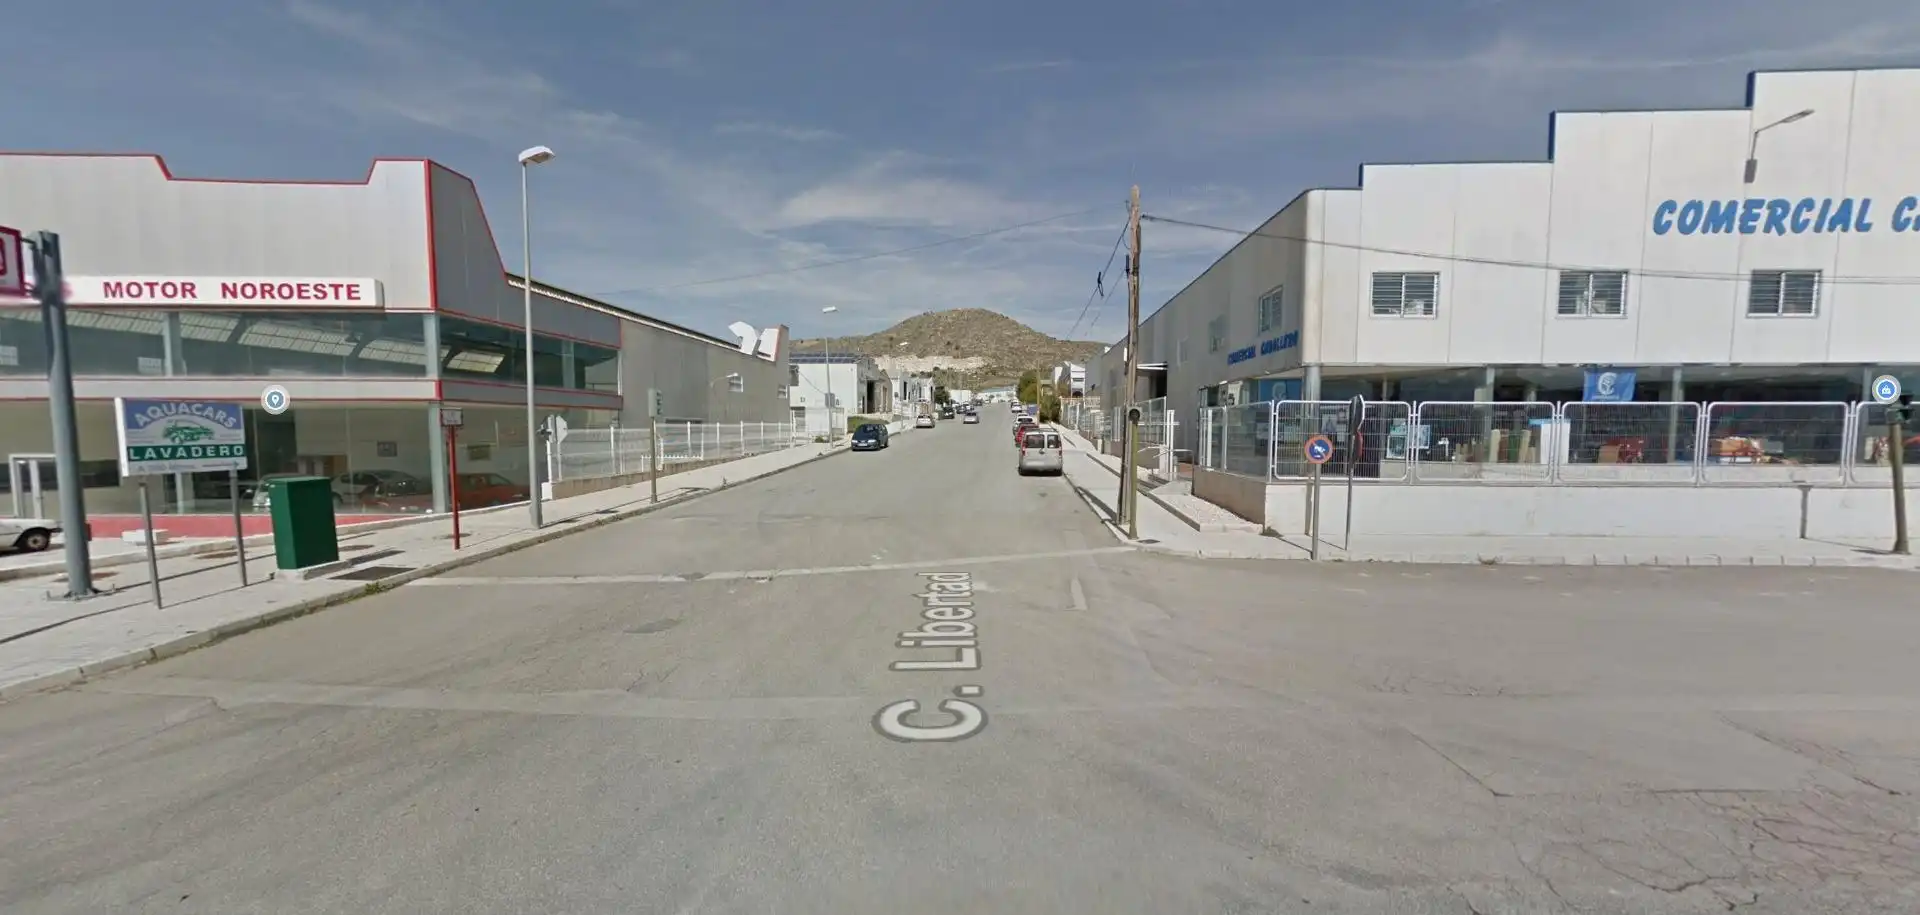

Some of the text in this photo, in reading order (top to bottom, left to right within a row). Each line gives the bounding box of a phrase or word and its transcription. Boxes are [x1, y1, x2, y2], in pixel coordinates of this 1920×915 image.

[1653, 198, 1873, 236] COMERCIAL
[103, 281, 361, 301] MOTOR NOROESTE
[134, 402, 236, 428] AQUACARS
[129, 445, 244, 460] LAVADERO
